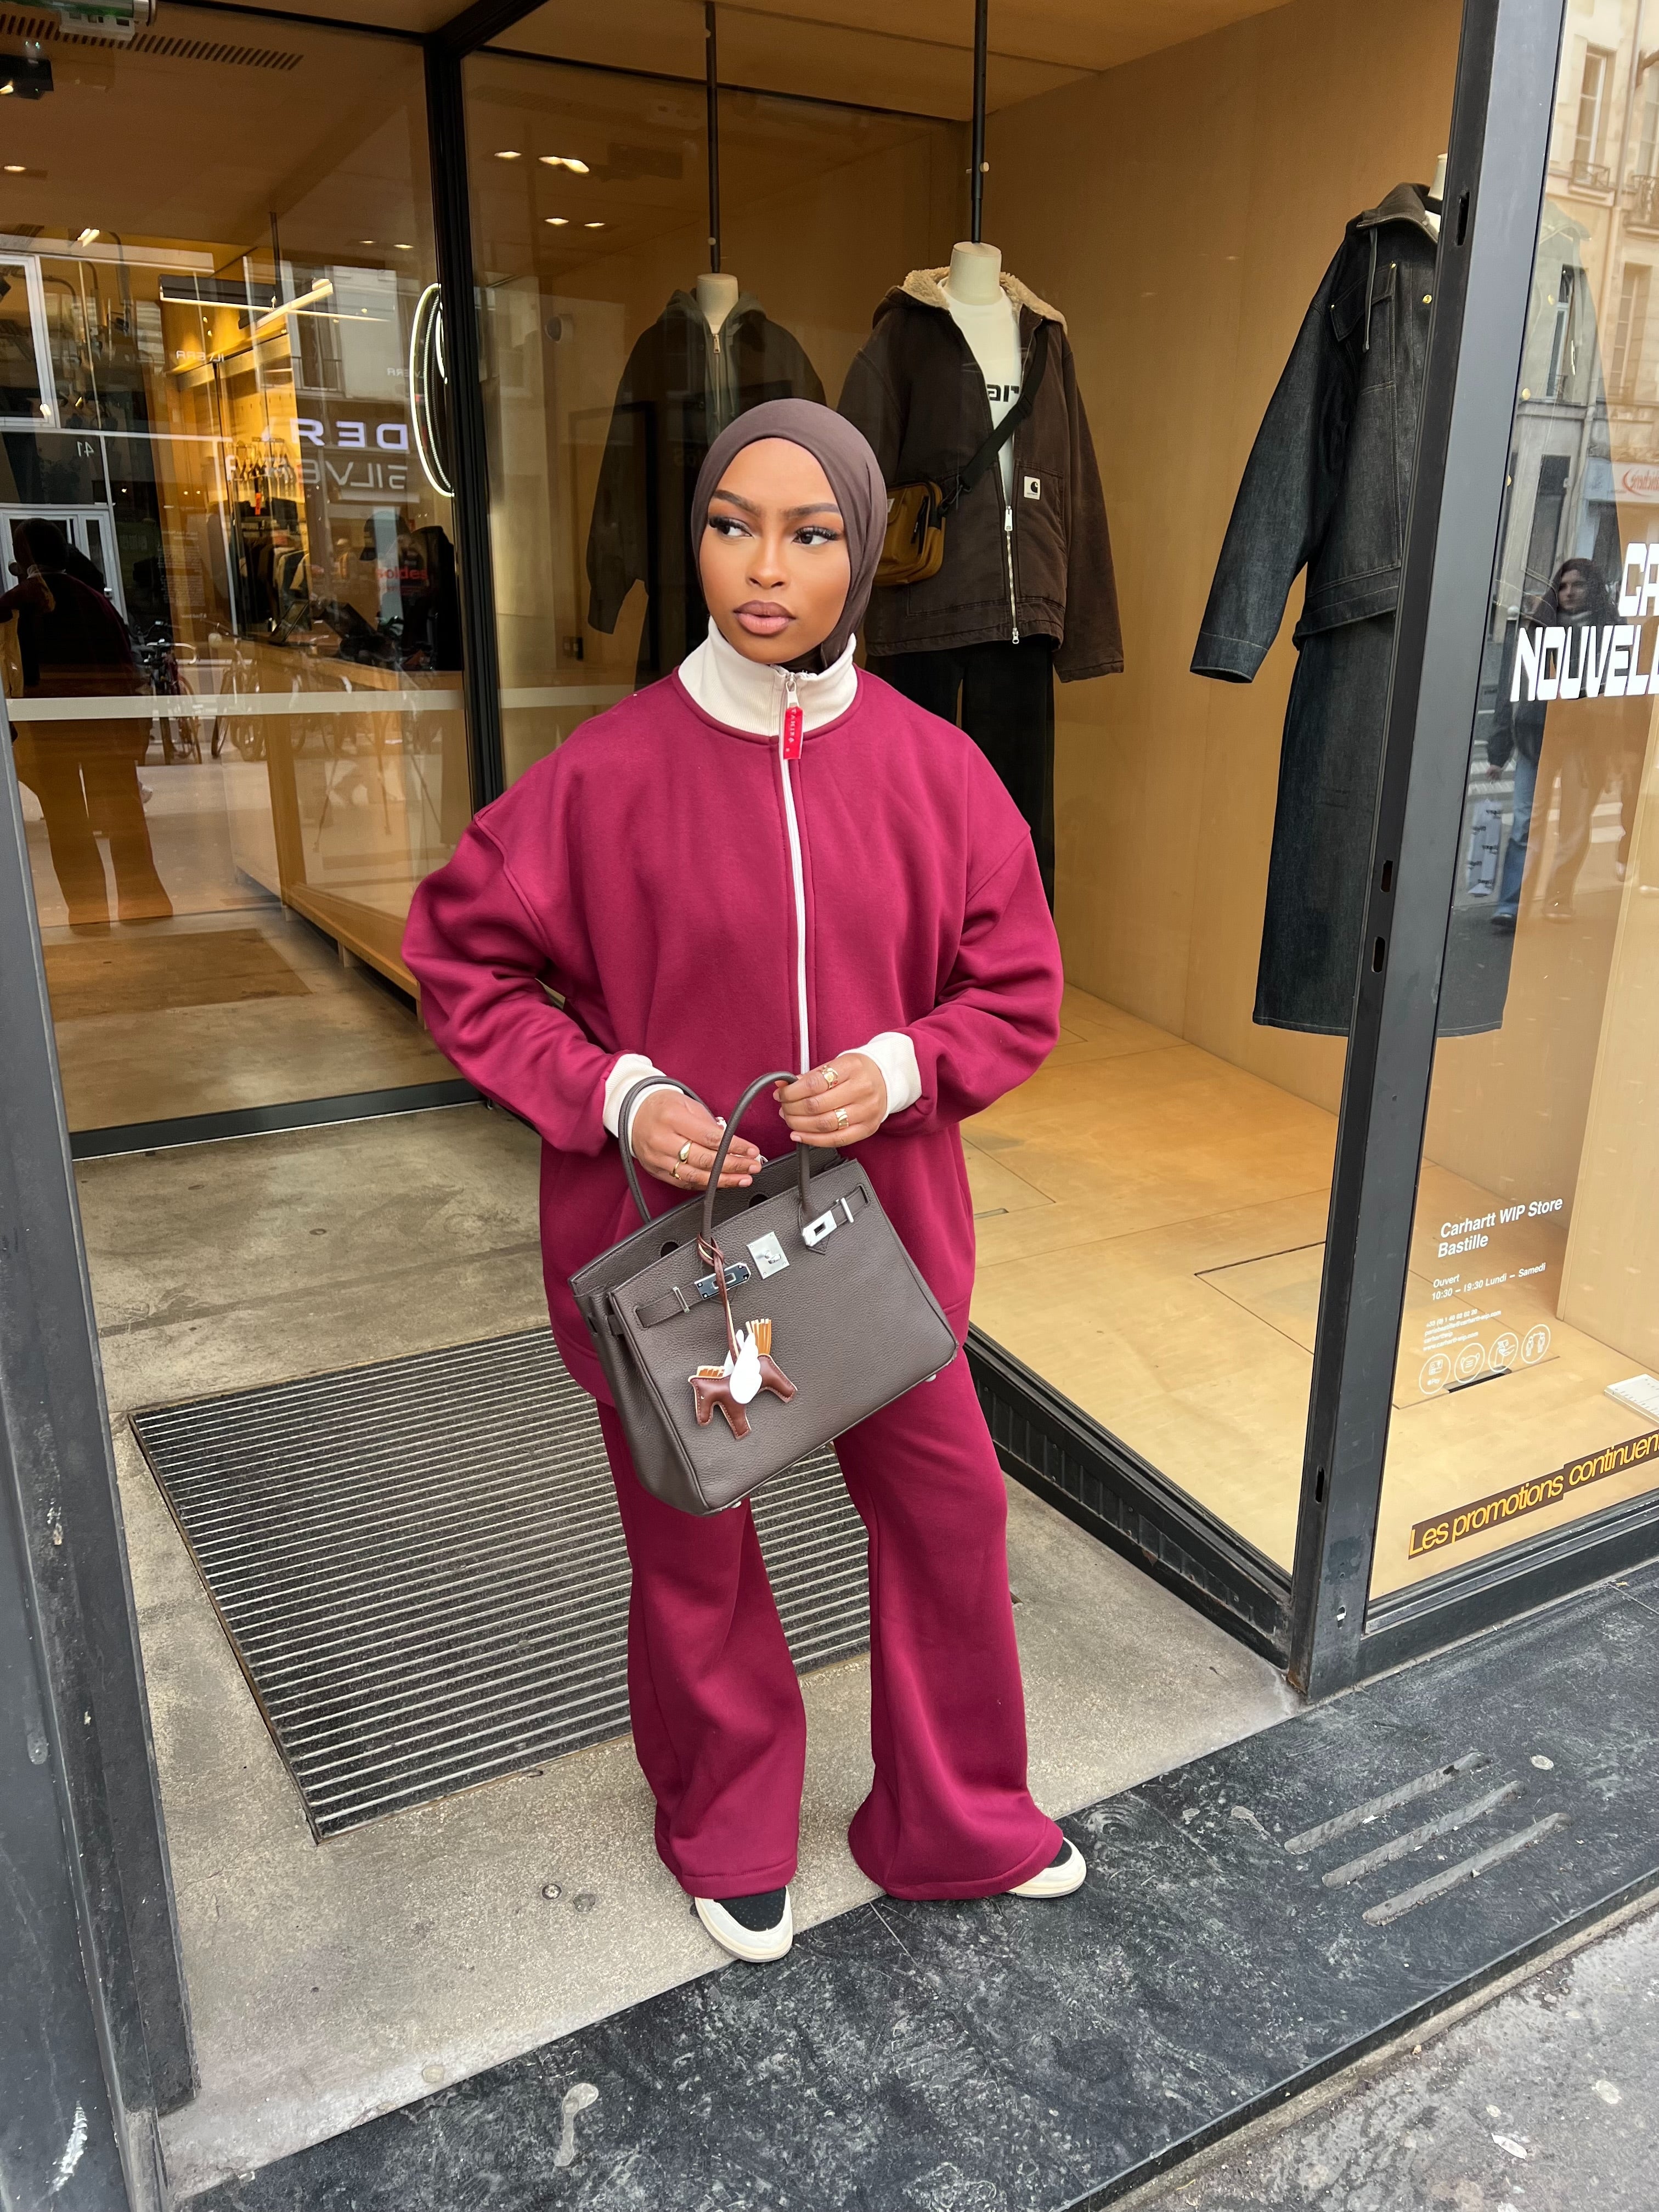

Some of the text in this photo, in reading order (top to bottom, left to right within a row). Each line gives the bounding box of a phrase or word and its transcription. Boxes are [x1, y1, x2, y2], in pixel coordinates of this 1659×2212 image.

[1441, 1198, 1563, 1238] Carhartt WIP Store
[1438, 1234, 1488, 1258] Bastille
[1432, 1288, 1453, 1301] 10:30
[1464, 1279, 1483, 1293] 19:30
[1485, 1273, 1507, 1286] Lundi
[1519, 1262, 1546, 1278] Samedi
[1433, 1274, 1460, 1288] Ouvert
[1409, 1432, 1659, 1556] Les promotions continuen
